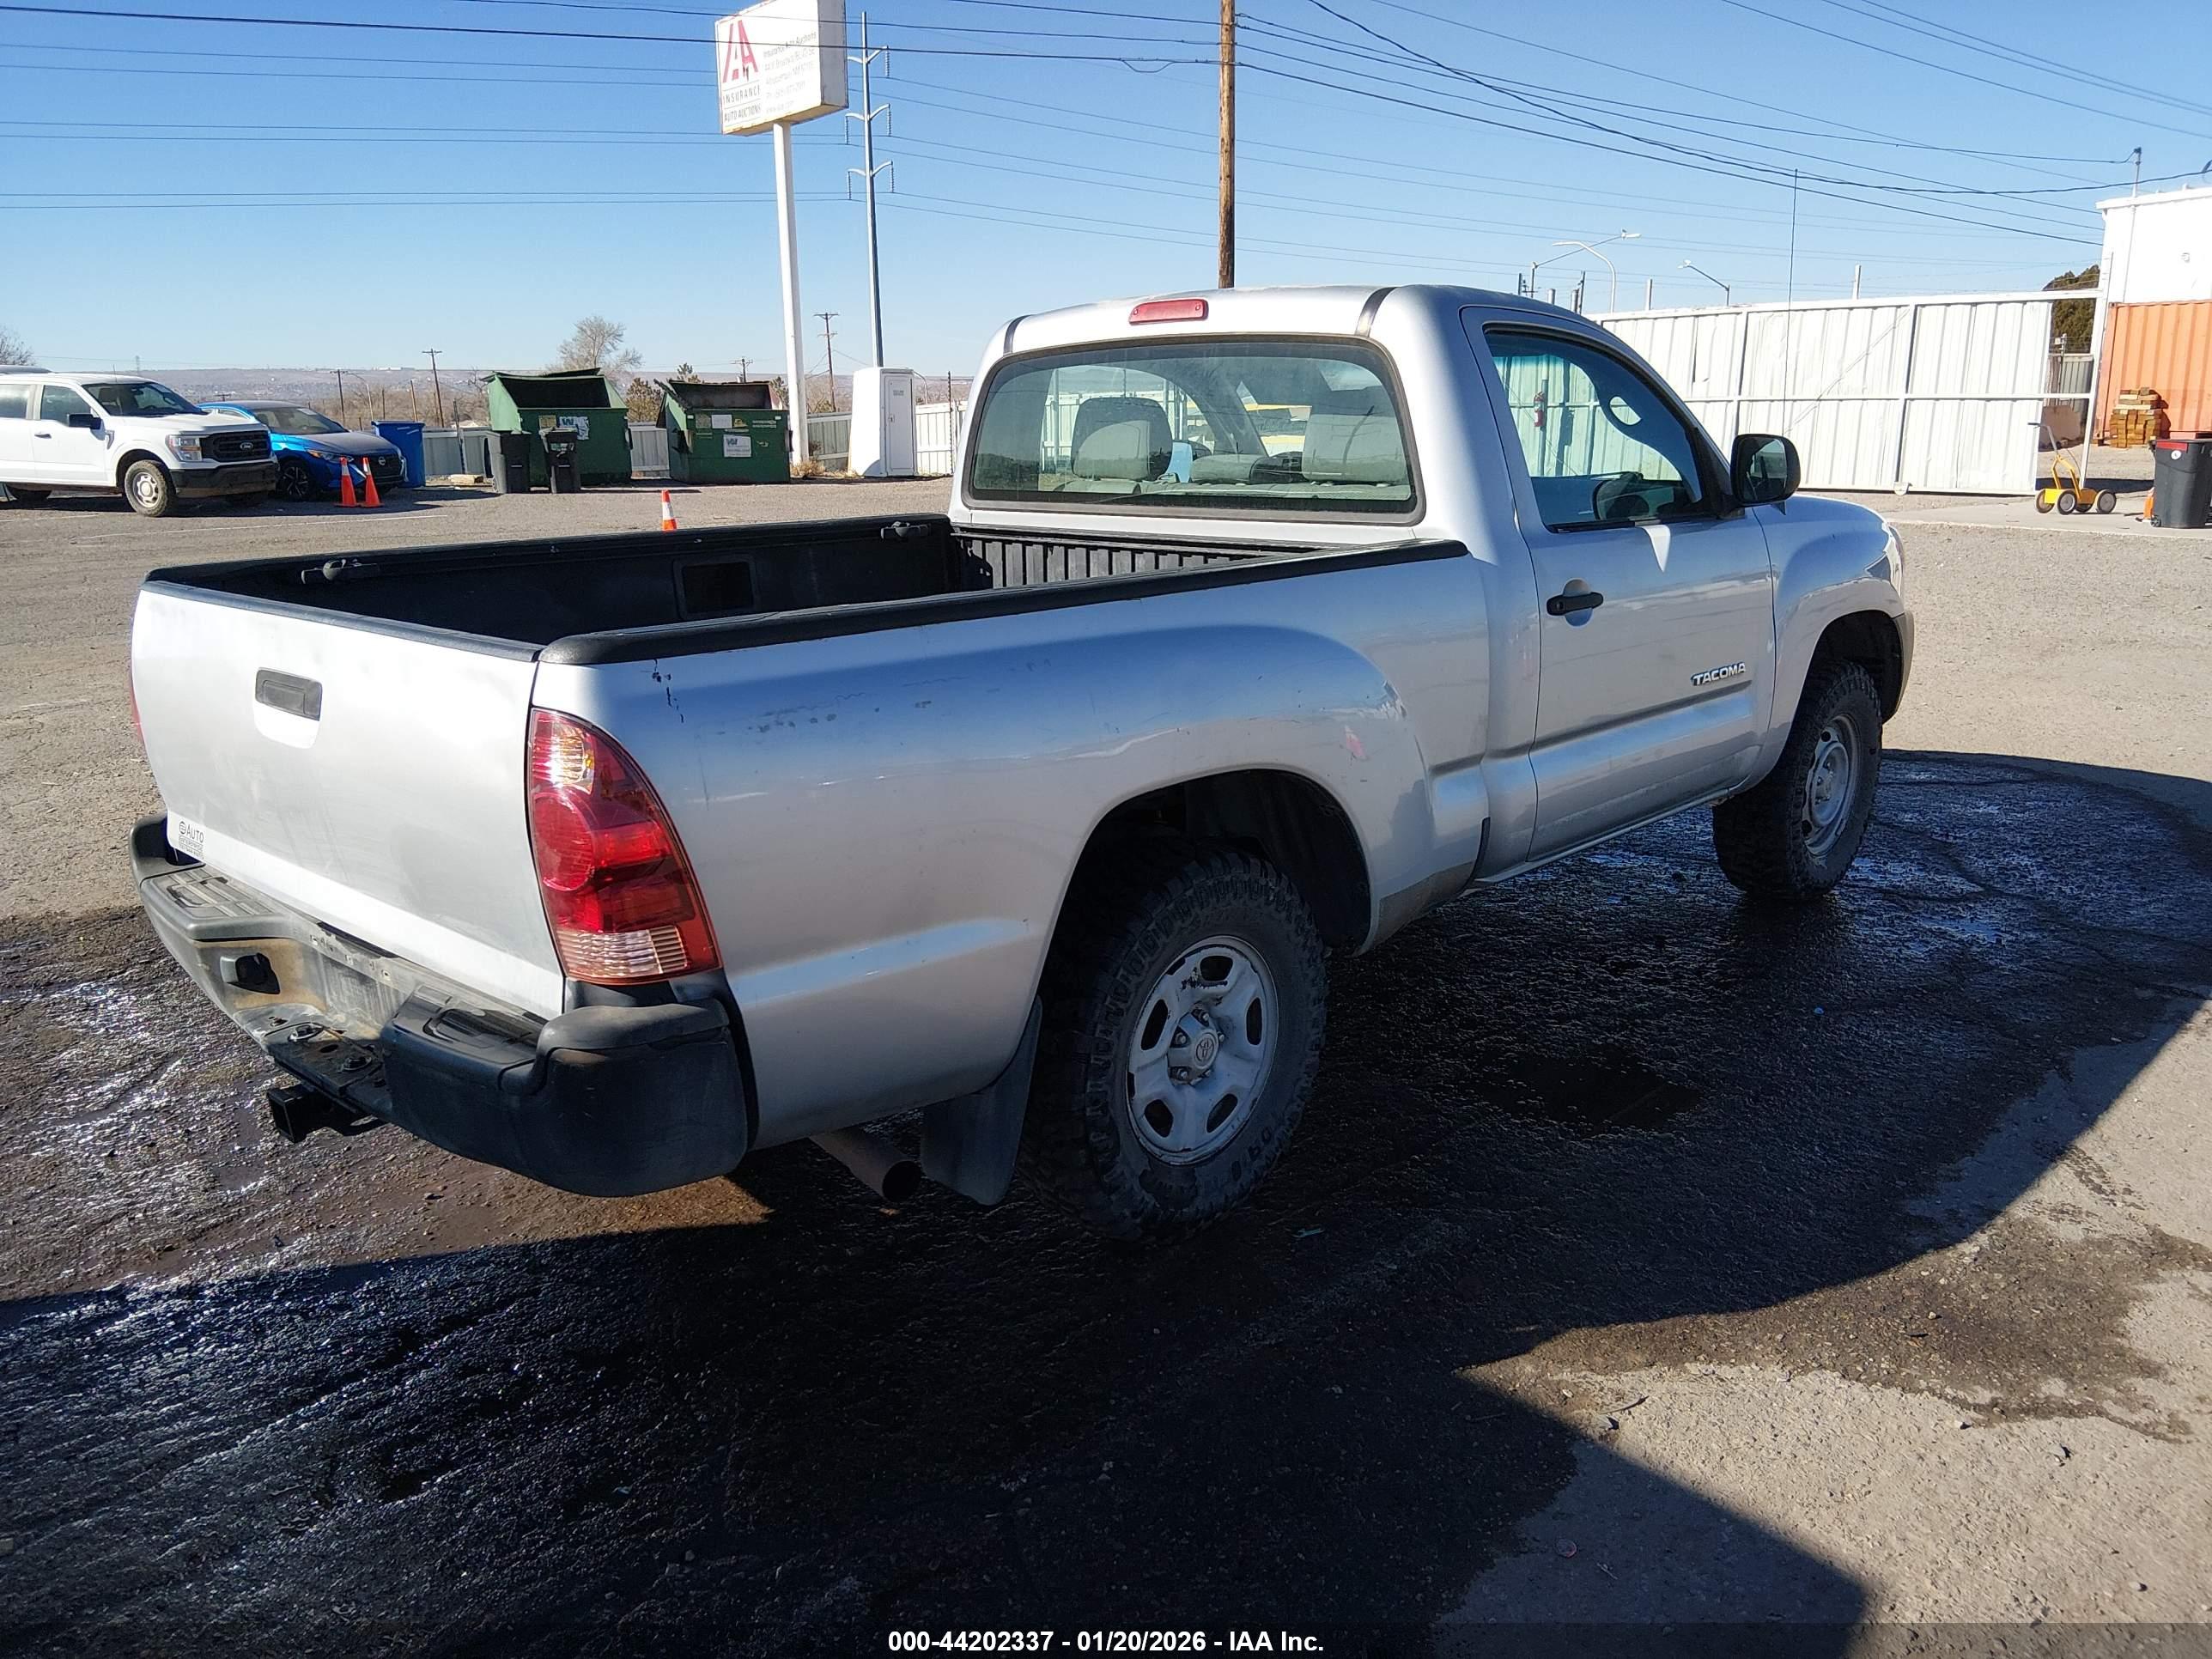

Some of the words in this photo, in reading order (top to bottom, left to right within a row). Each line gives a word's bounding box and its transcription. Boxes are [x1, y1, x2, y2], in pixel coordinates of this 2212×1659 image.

[723, 84, 761, 105] INSURANCE
[724, 110, 738, 123] AUTO
[1691, 662, 1747, 686] TACOMA
[186, 823, 204, 843] AUTO
